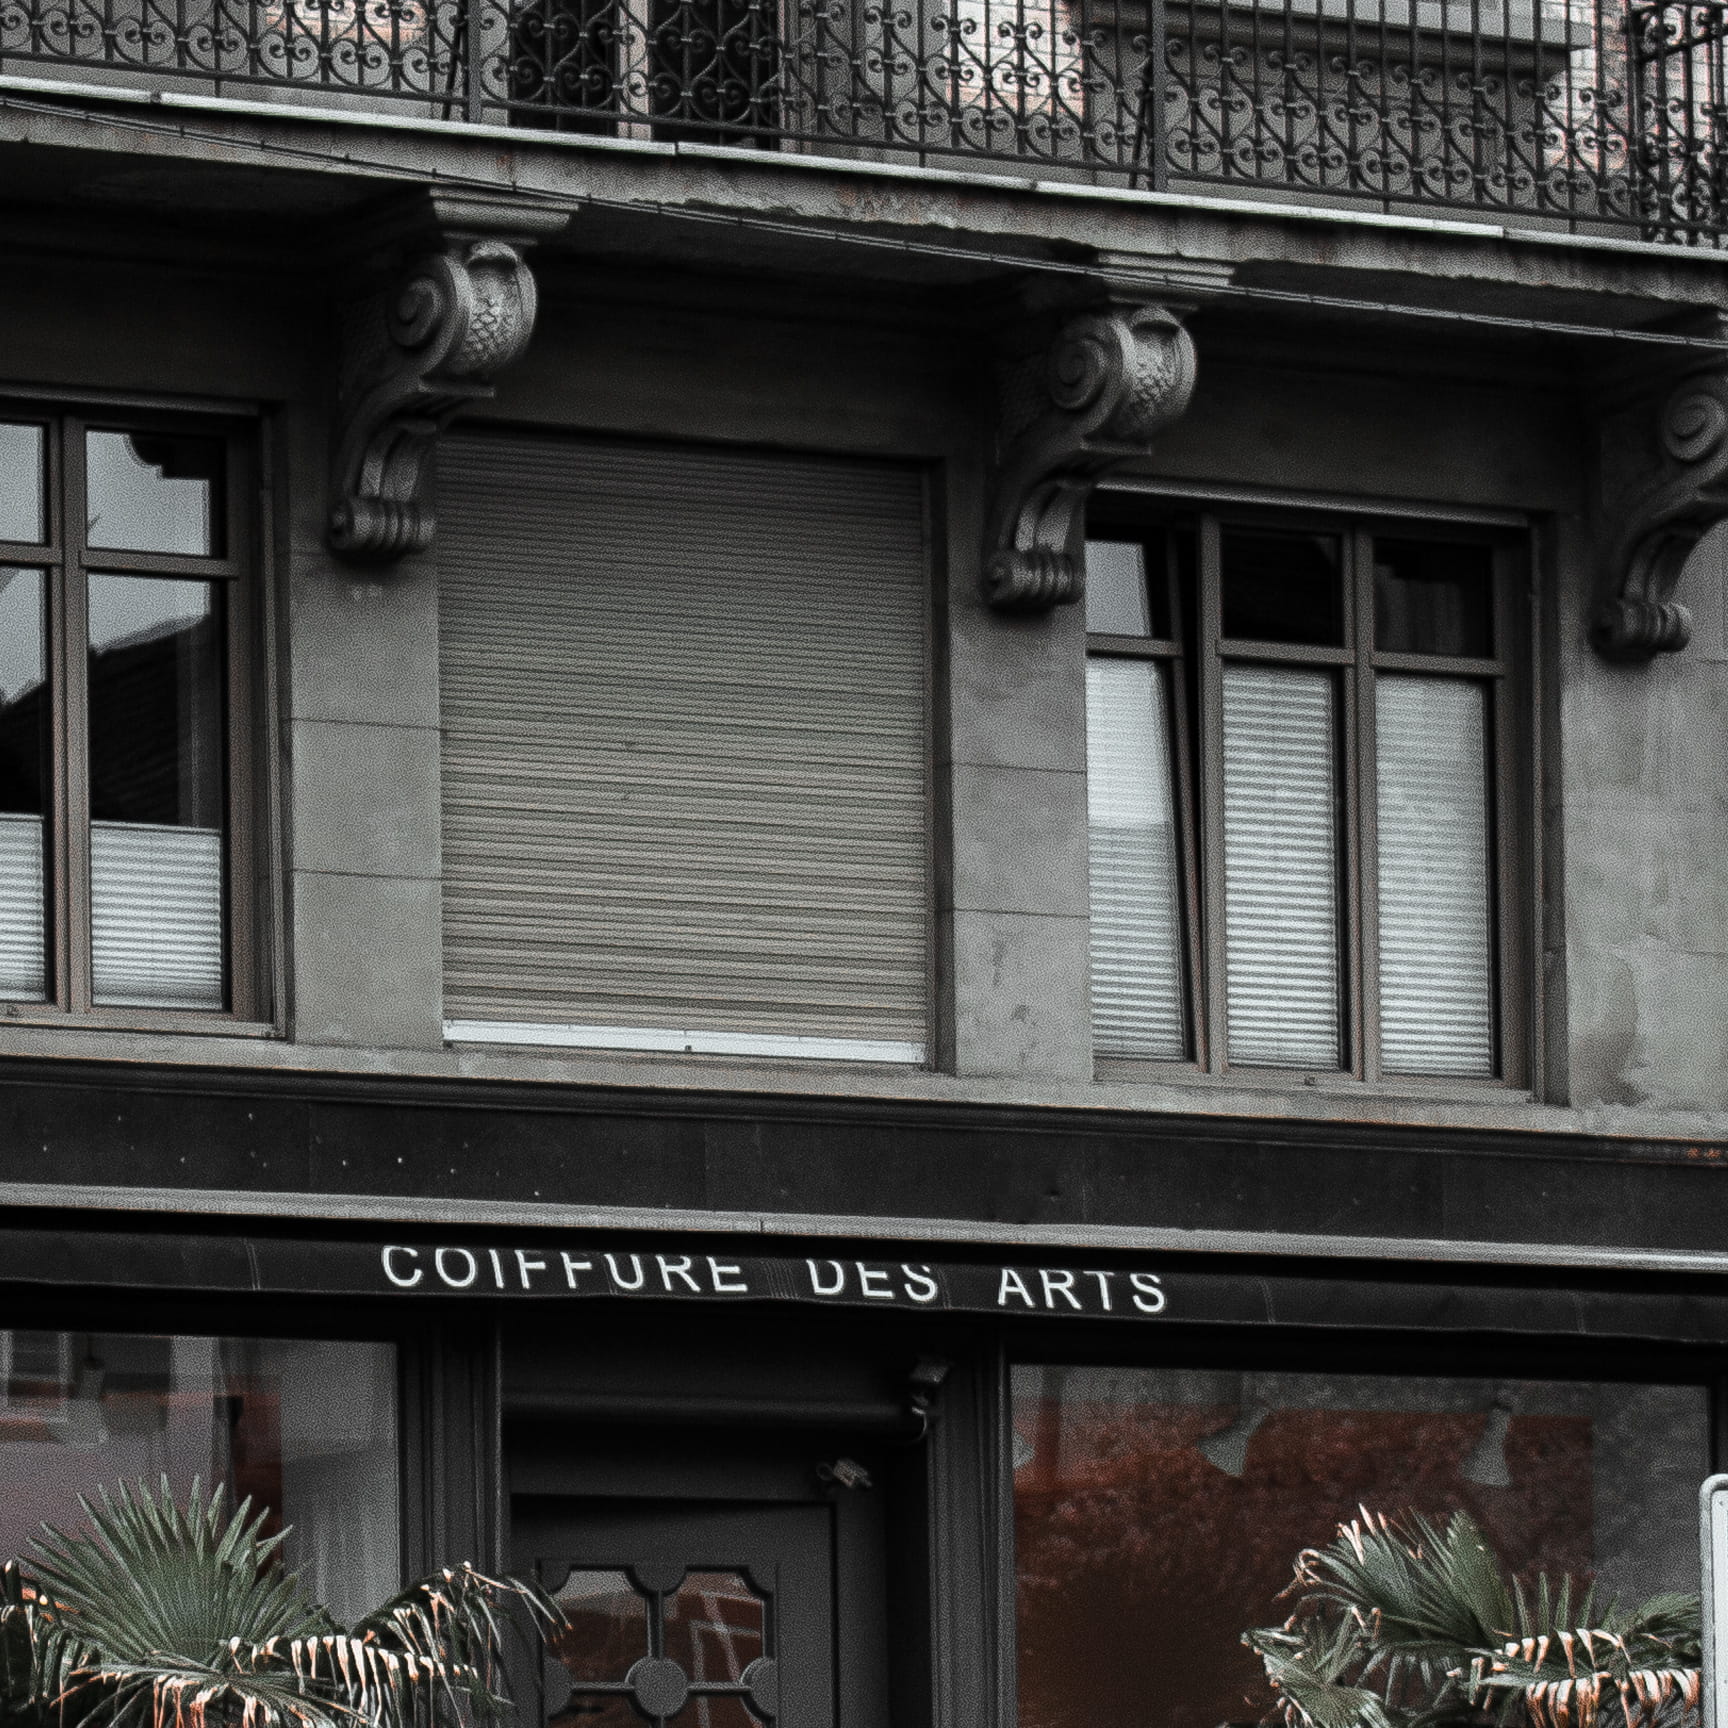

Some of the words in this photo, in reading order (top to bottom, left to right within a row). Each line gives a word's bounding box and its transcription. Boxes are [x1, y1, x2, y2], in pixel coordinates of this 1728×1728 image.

[381, 1245, 748, 1293] COIFFURE
[805, 1258, 939, 1302] DES
[998, 1267, 1166, 1313] ARTS
